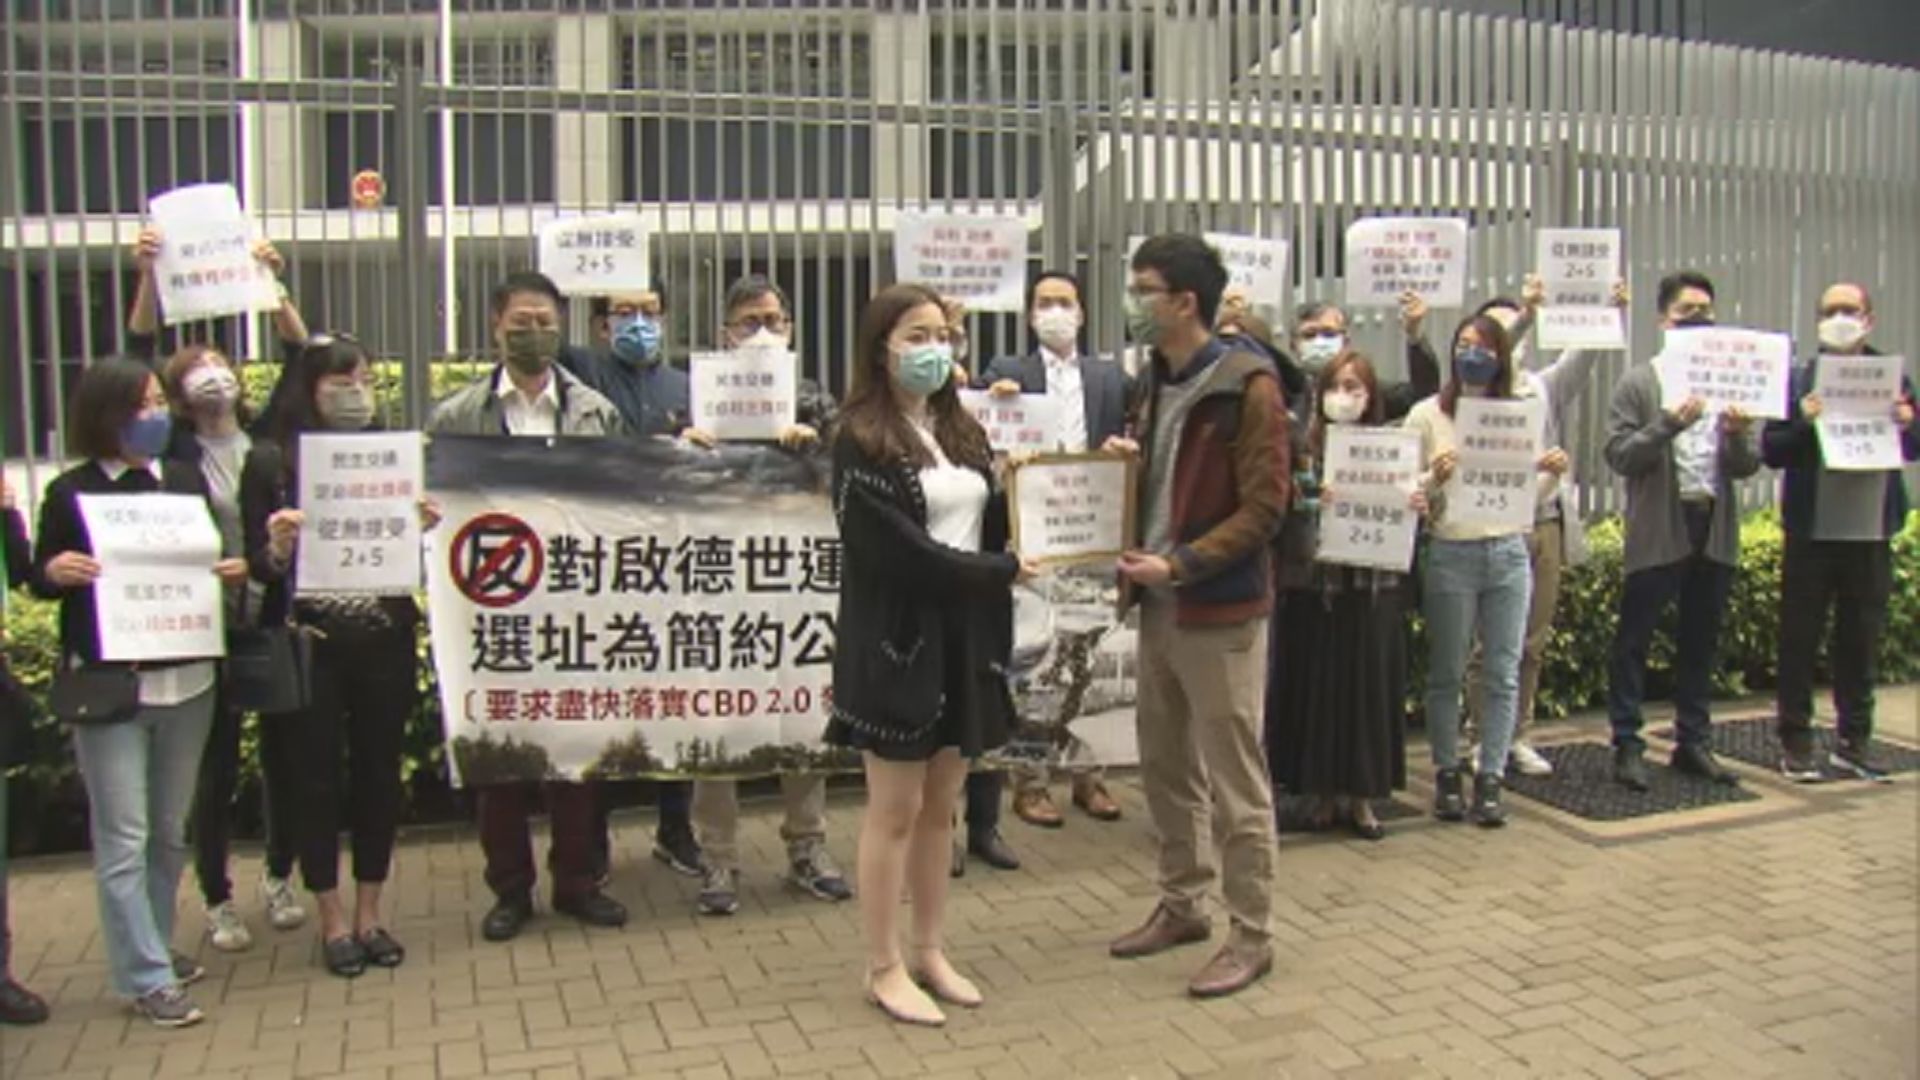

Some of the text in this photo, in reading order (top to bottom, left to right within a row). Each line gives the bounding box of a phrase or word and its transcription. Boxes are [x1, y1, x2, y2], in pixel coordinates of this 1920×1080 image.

[576, 254, 615, 273] 2+5
[1564, 262, 1595, 278] 2+5
[1349, 525, 1385, 544] 2+5
[340, 547, 384, 567] 2+5
[471, 611, 837, 673] 選址為簡約公
[765, 686, 812, 714] 2.0
